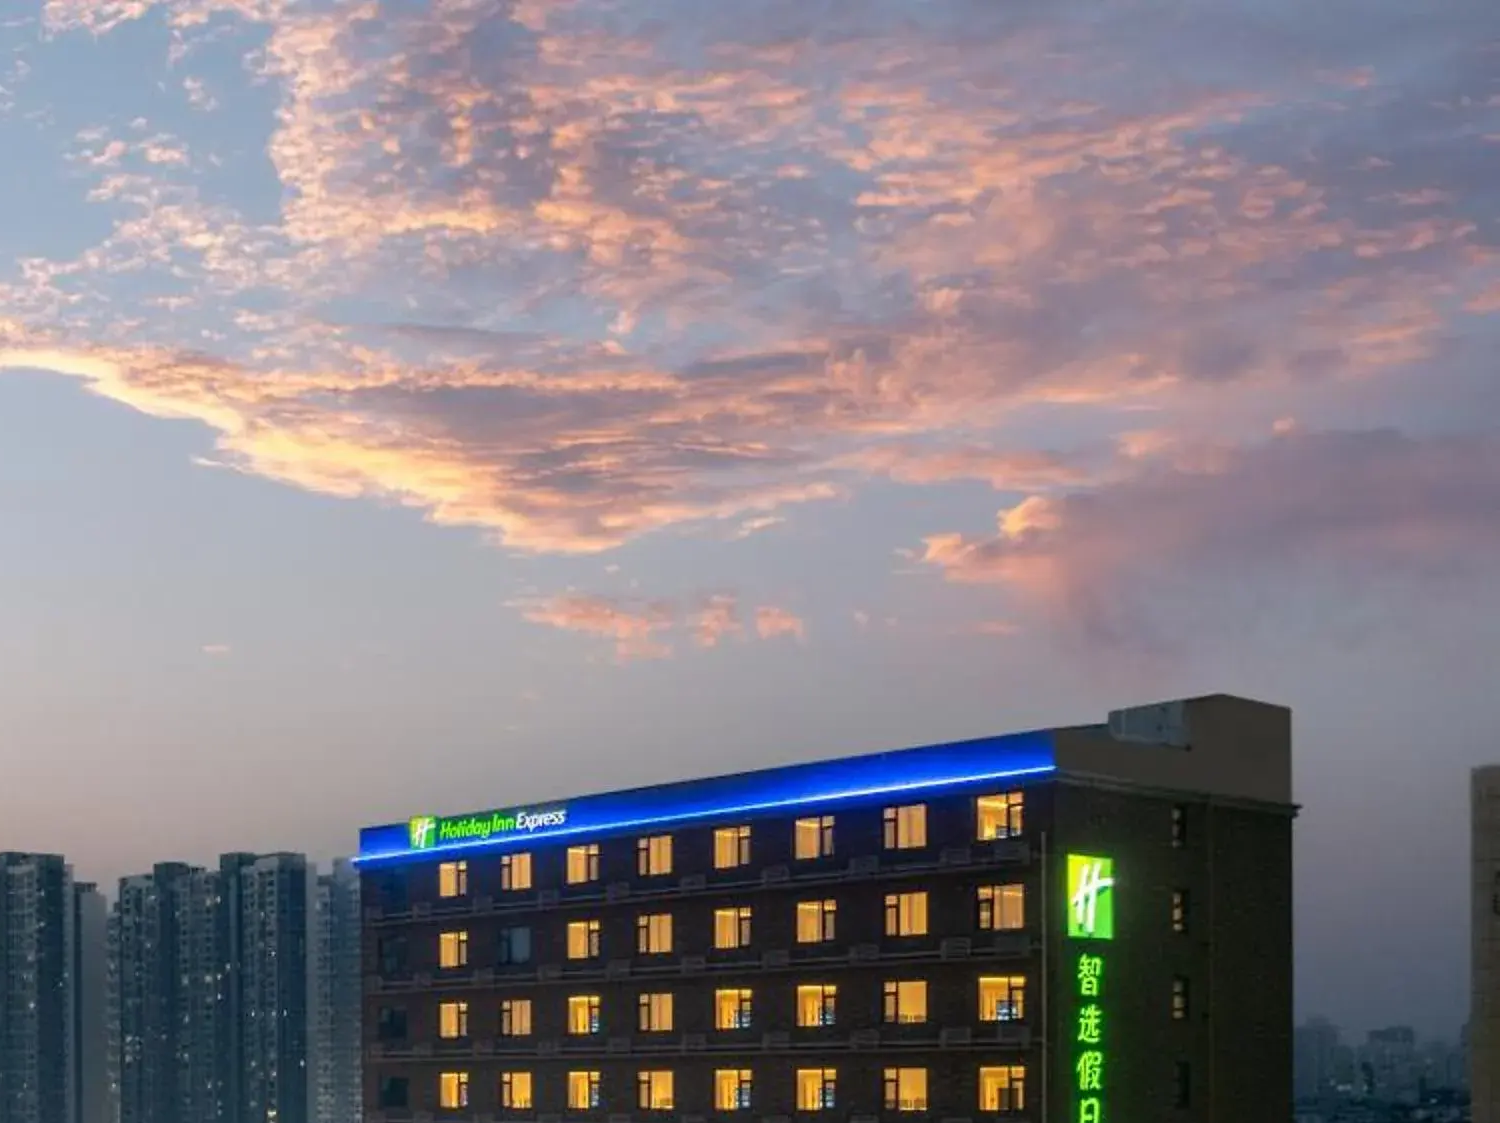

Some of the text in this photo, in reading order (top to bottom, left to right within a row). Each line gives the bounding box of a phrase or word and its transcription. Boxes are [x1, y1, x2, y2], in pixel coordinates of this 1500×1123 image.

[439, 810, 566, 839] Holiday Inn Express
